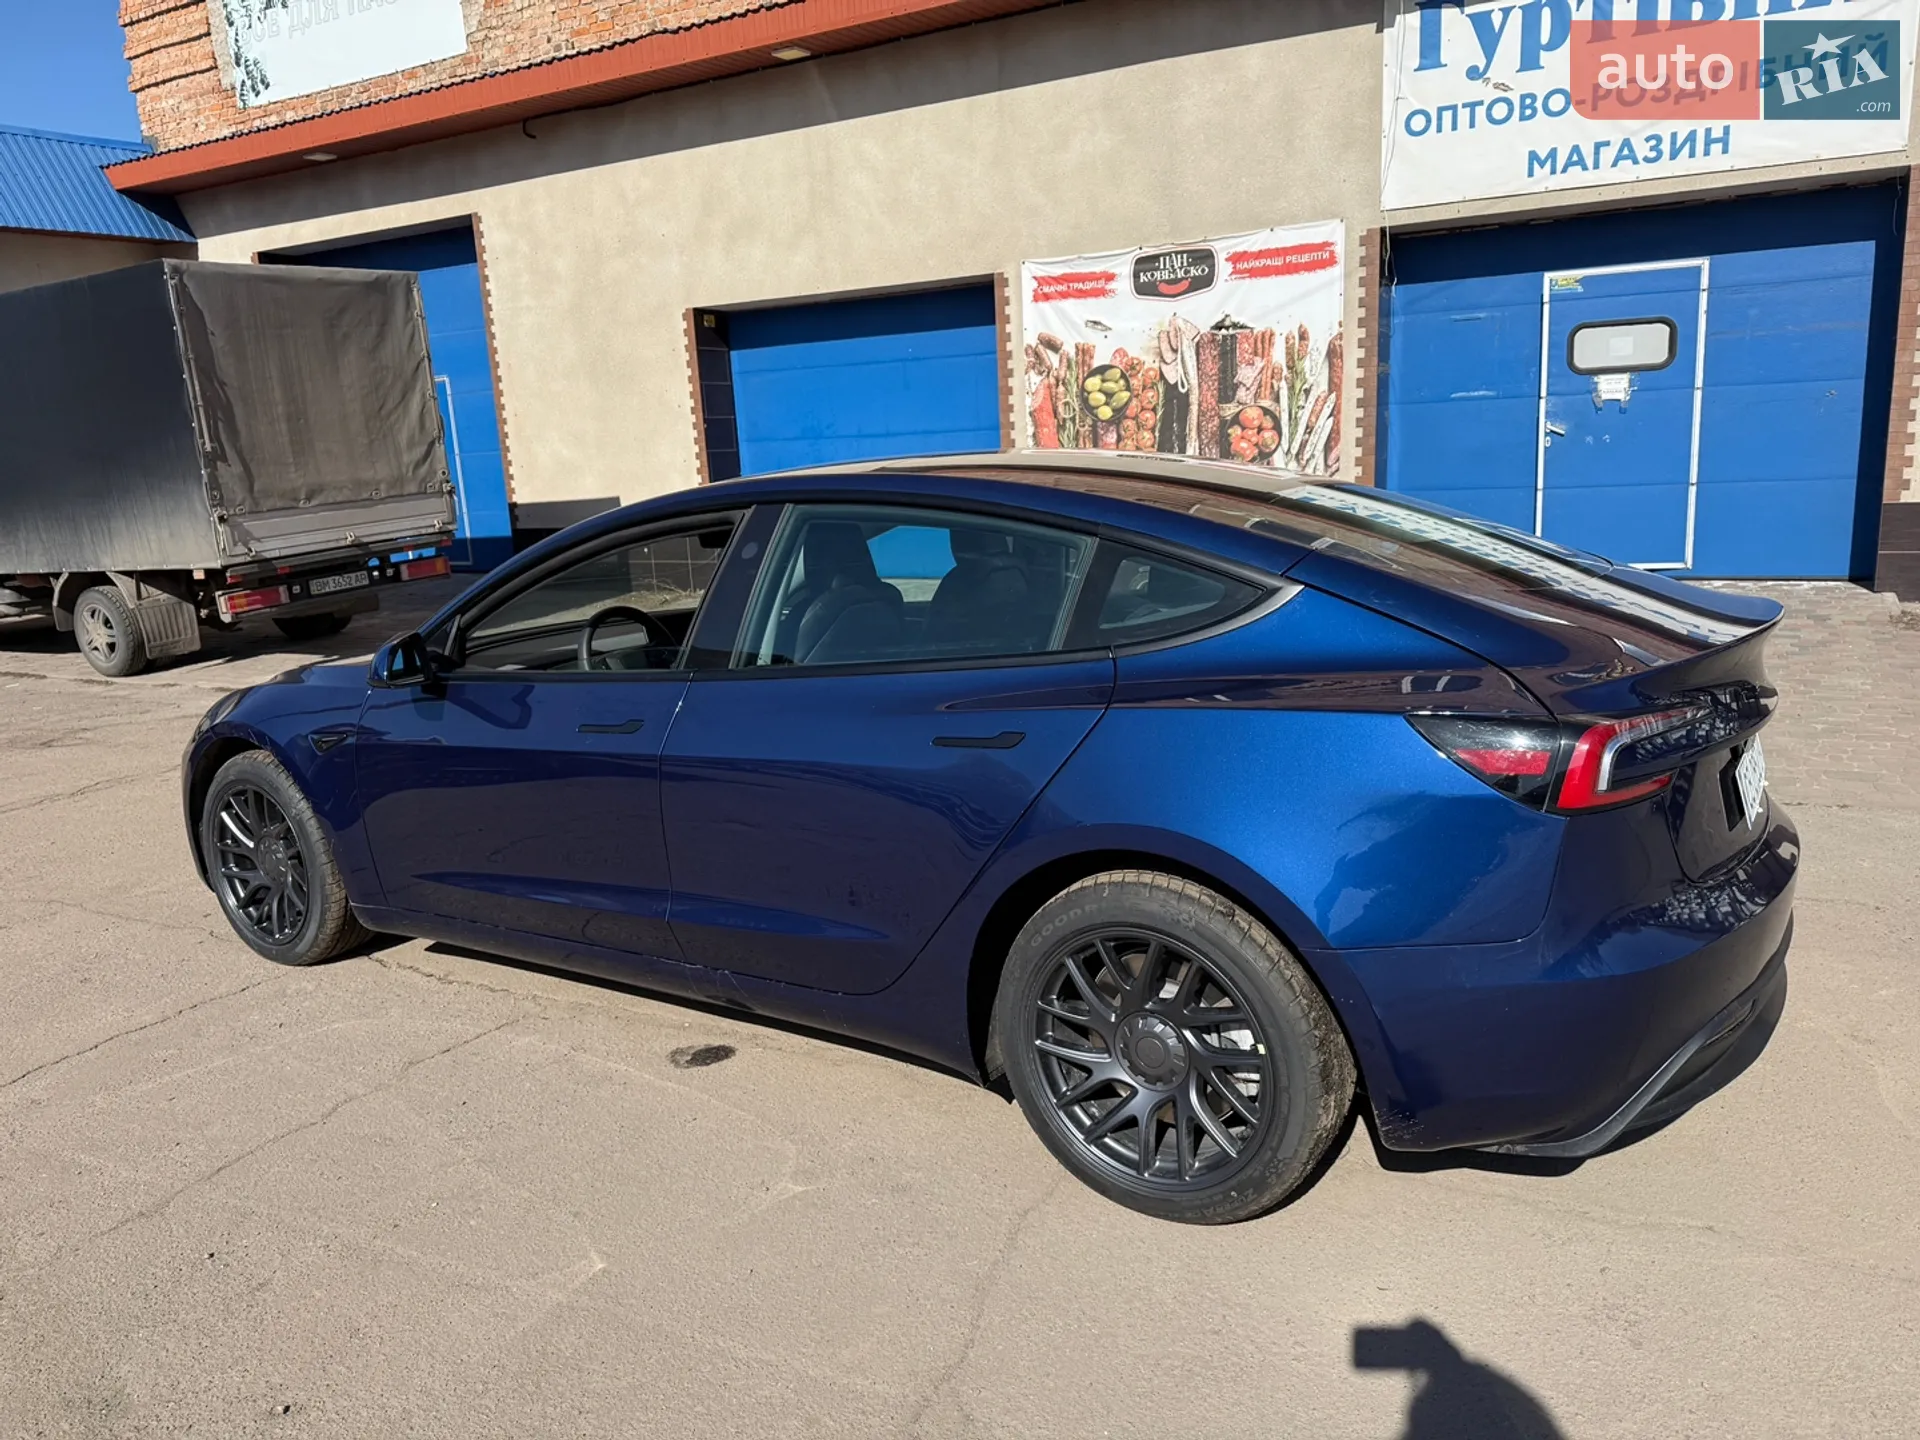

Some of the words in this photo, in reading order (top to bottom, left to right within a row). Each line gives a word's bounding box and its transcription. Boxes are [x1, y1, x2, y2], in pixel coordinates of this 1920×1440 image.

[1527, 124, 1731, 178] МАГАЗИН
[1236, 255, 1284, 270] НАЙКРАЩІ
[1286, 250, 1330, 264] РЕЦЕПТИ
[1140, 265, 1209, 283] КОВБАСКО
[1039, 283, 1068, 293] СМАЧНІ
[331, 574, 353, 589] 3652
